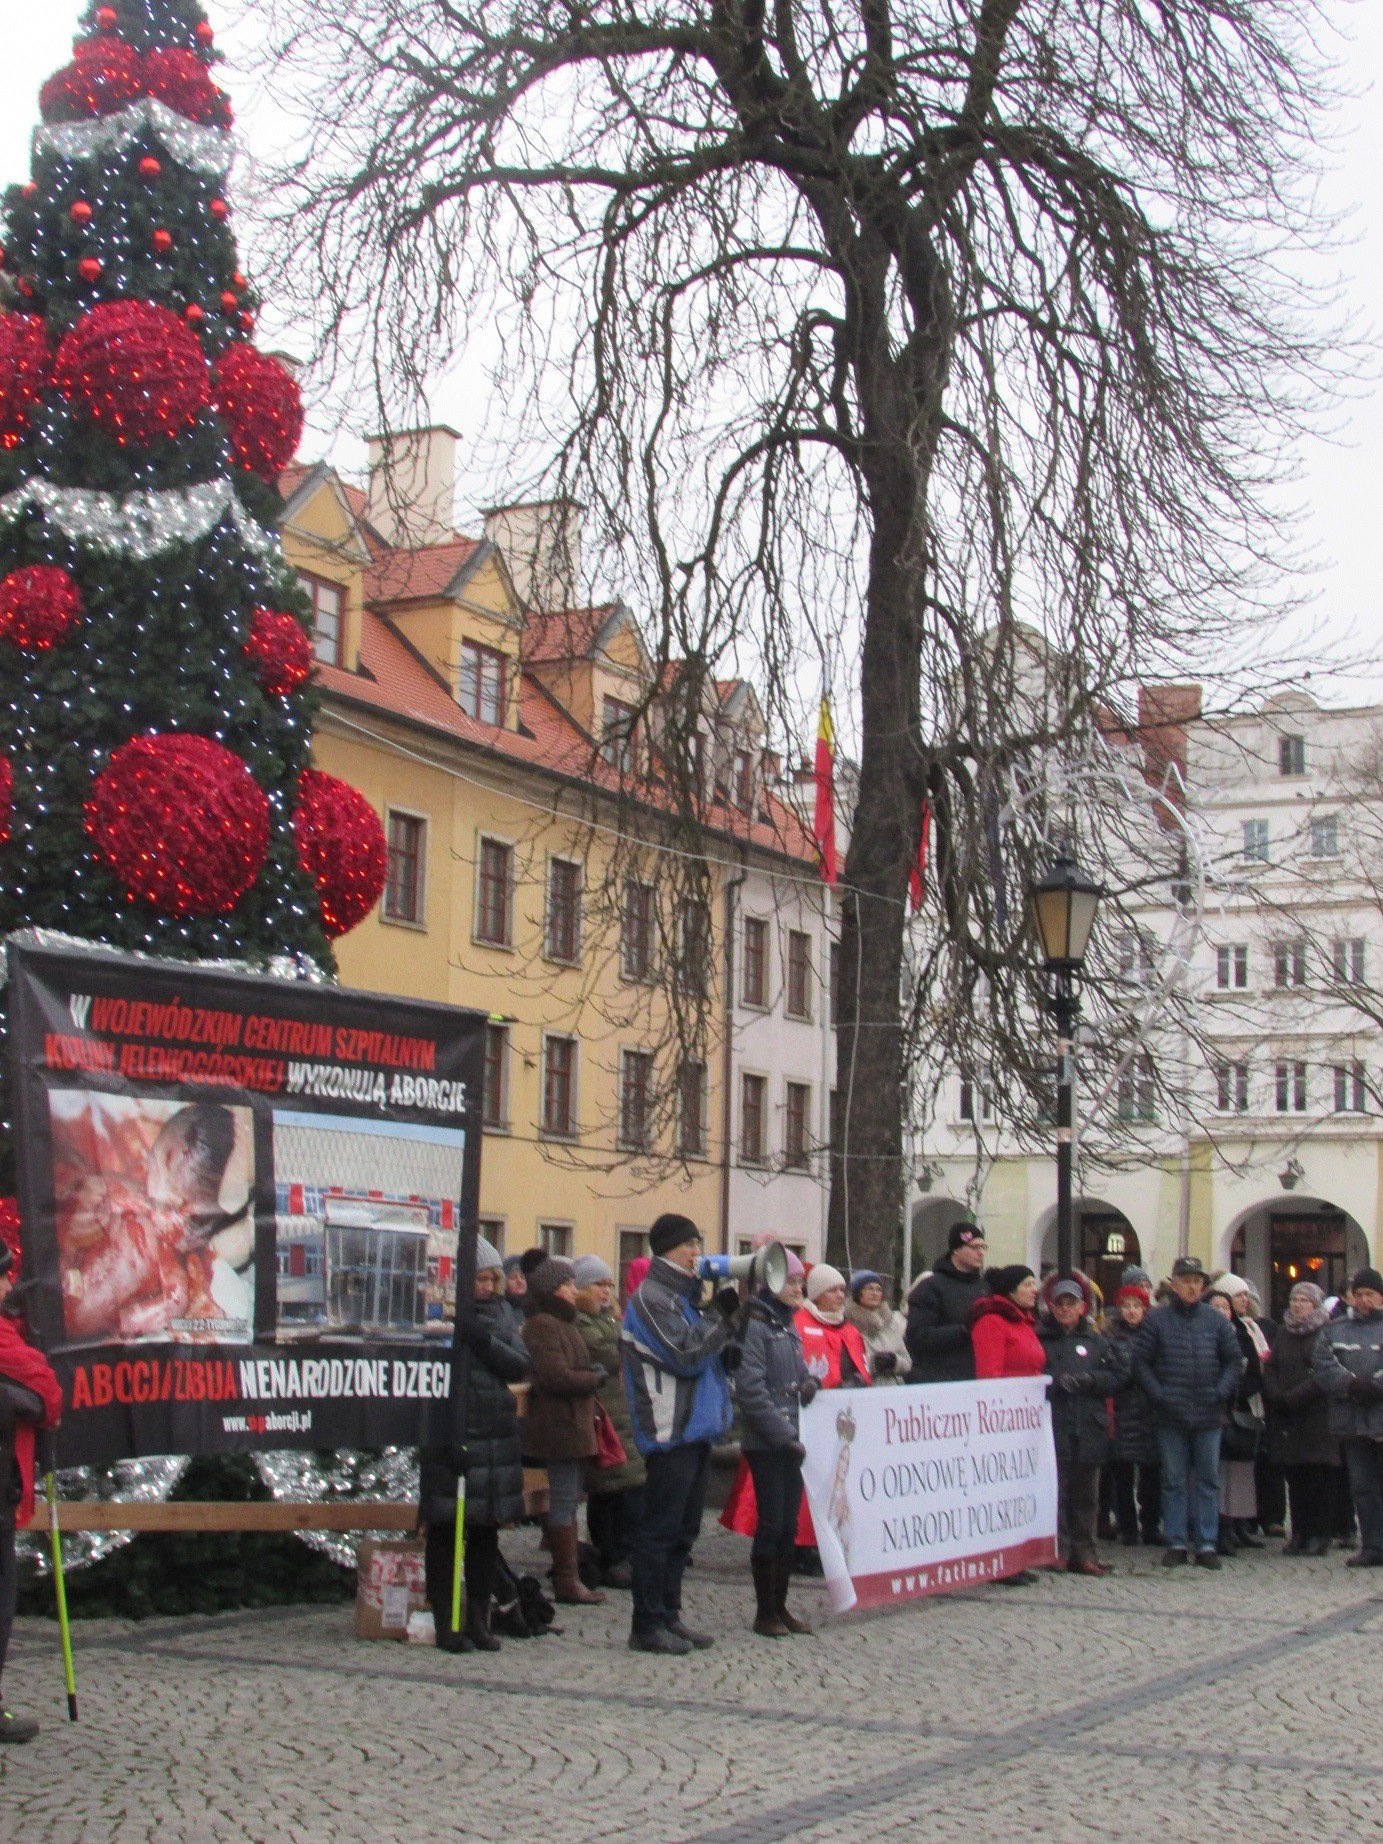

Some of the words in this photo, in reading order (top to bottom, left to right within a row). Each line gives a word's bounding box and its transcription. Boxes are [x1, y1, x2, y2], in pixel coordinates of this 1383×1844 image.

[70, 993, 92, 1030] W
[91, 996, 242, 1046] WOJEWÓDZKIM
[244, 1014, 333, 1058] CENTRUM
[335, 1026, 437, 1071] SZPITALNYM
[286, 1061, 387, 1112] WYKONUJĄ
[389, 1072, 468, 1114] ABORCJE
[884, 1402, 971, 1448] Publiczny
[860, 1467, 876, 1502] O
[882, 1455, 968, 1498] ODNOWĘ
[882, 1506, 962, 1552] NARODU
